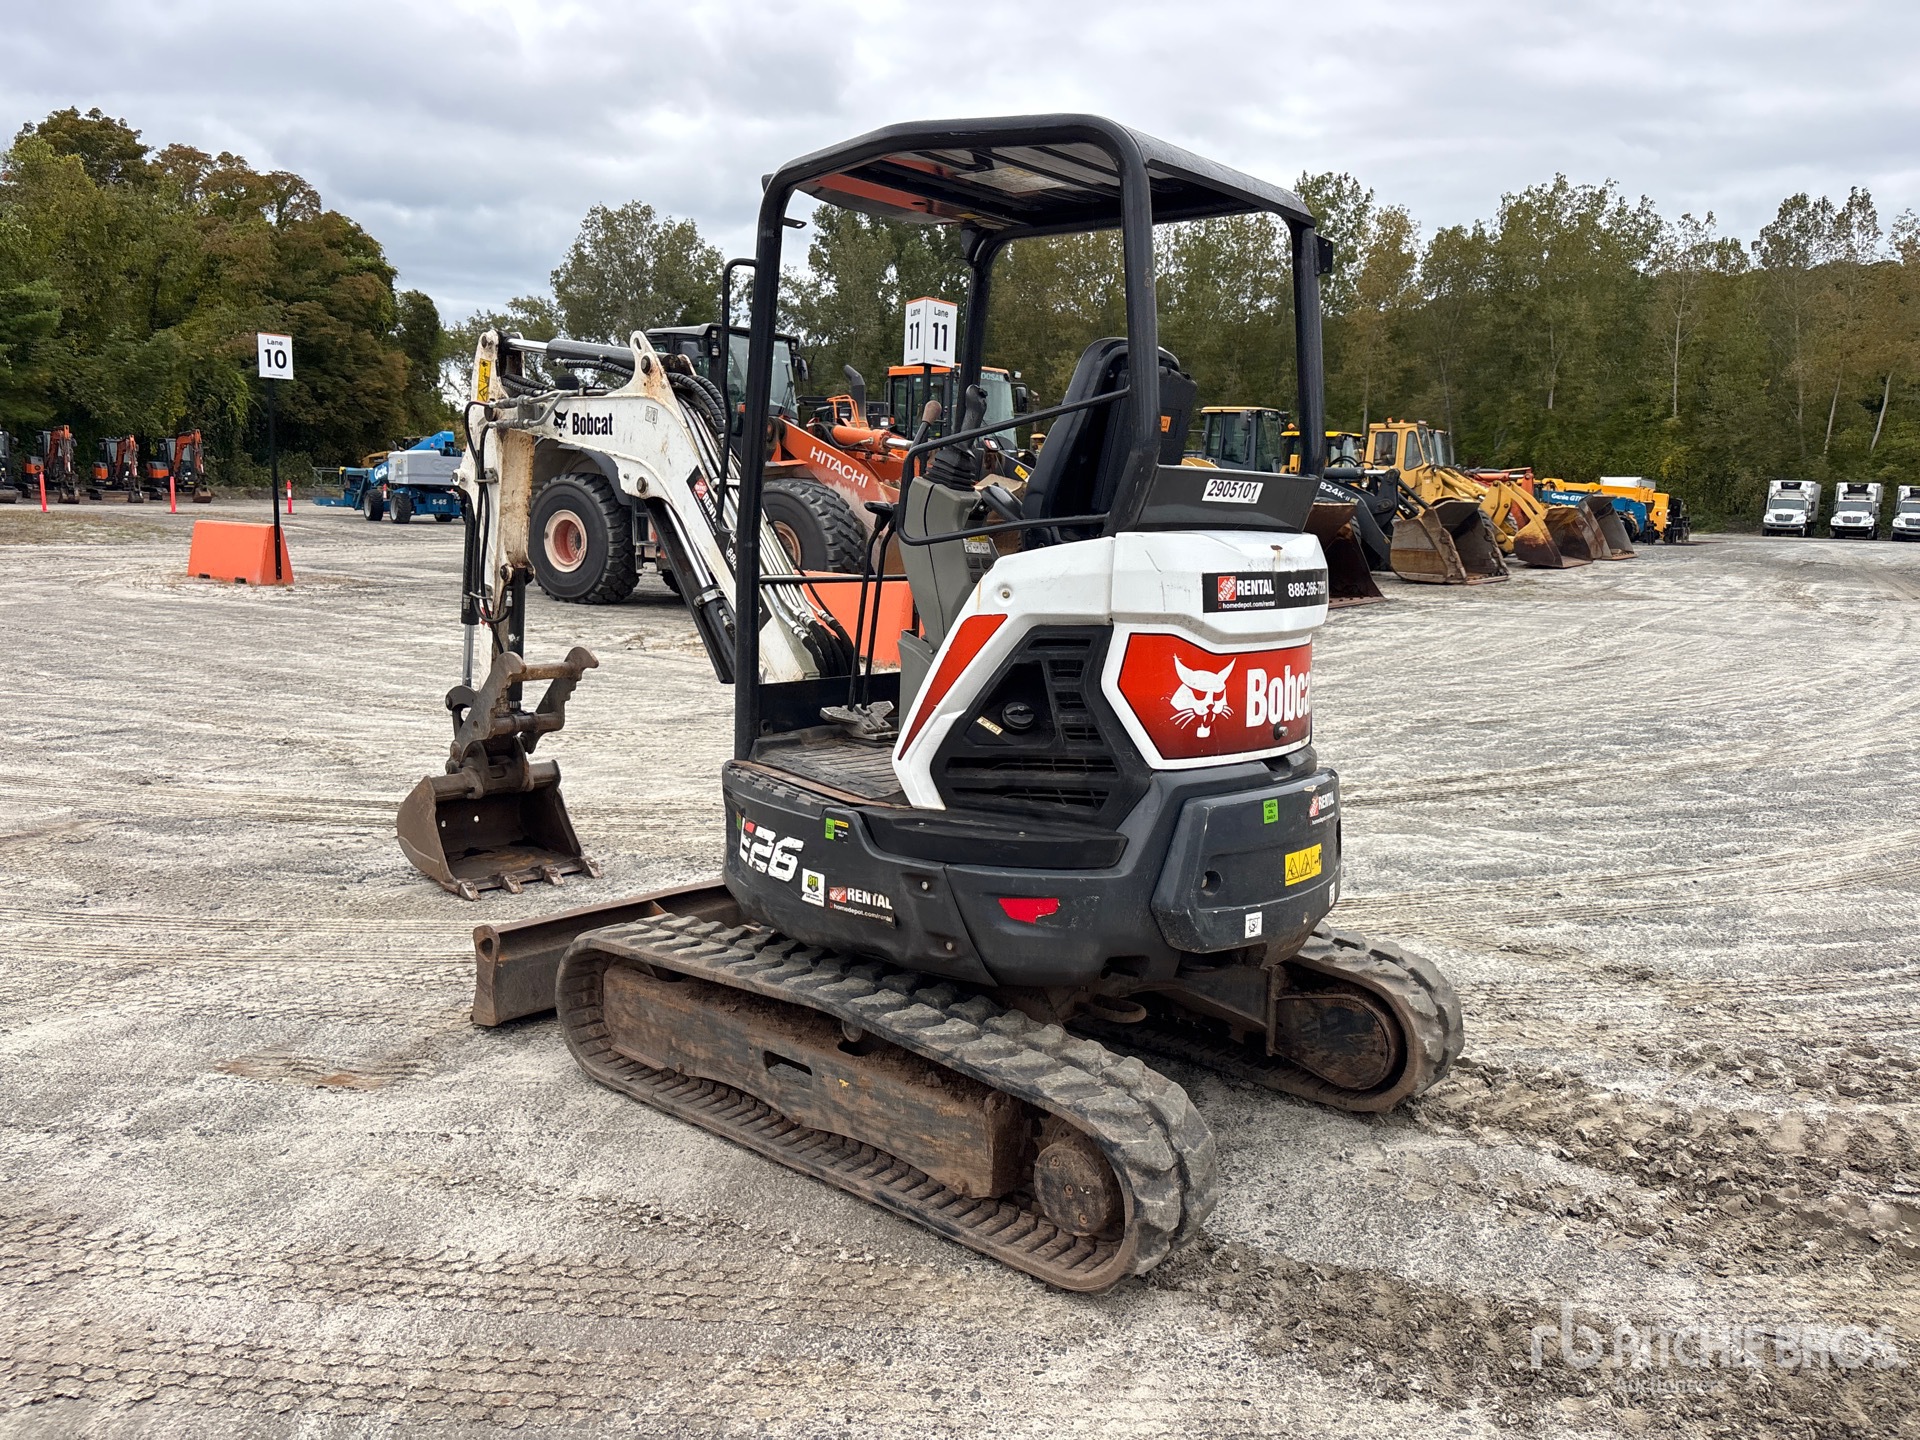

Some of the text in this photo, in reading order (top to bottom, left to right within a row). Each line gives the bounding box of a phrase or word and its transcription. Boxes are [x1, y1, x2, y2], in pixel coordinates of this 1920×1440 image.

[910, 308, 921, 317] Lane
[934, 307, 948, 318] Lane
[266, 338, 283, 346] Lane
[909, 321, 920, 351] 11
[932, 322, 948, 352] 11
[264, 348, 287, 369] 10
[572, 412, 613, 435] Bobcat
[809, 446, 869, 489] HITACHI
[1207, 480, 1259, 499] 2905101
[1236, 579, 1274, 596] RENTAL
[1245, 664, 1311, 728] Bobca
[739, 817, 804, 882] E26
[807, 874, 818, 887] 811
[847, 887, 893, 910] RENTAL
